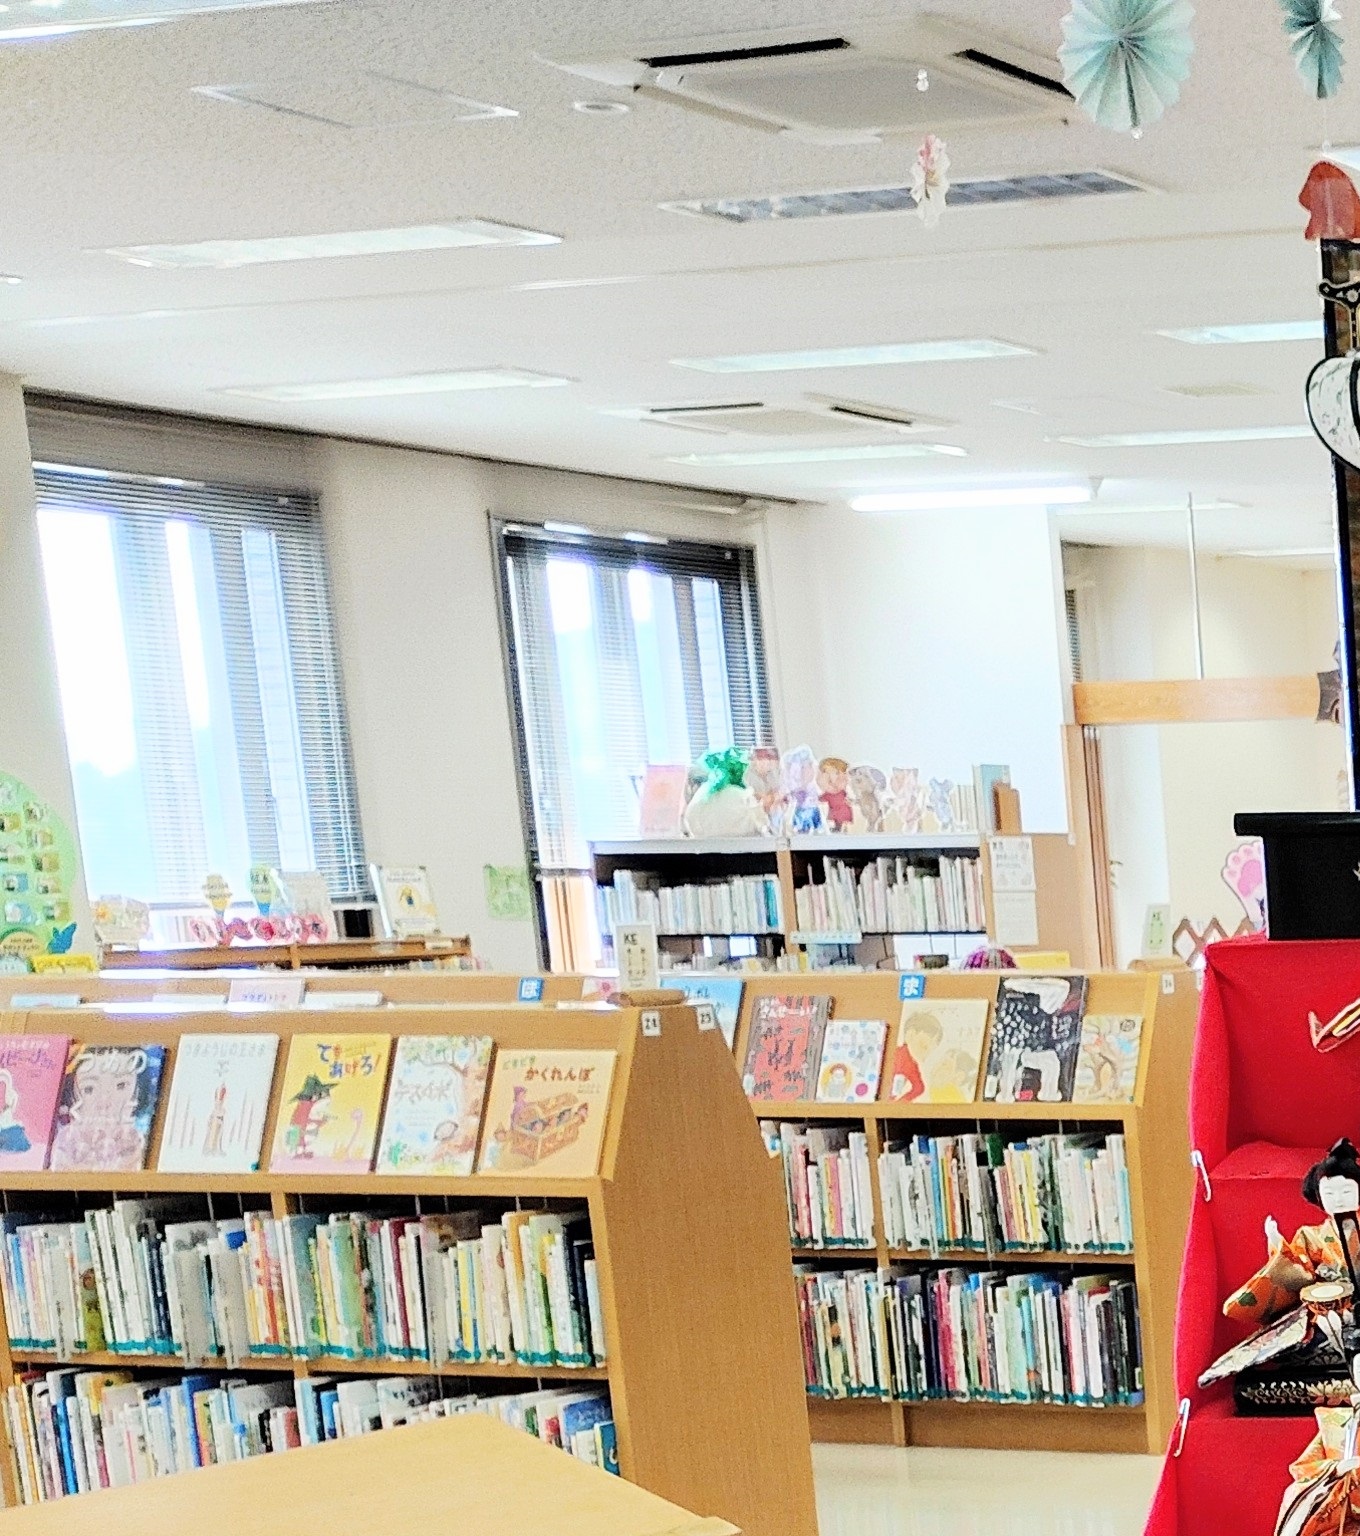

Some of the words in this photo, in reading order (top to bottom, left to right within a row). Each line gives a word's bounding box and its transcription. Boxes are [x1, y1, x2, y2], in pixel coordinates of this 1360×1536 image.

[902, 976, 920, 996] ま
[525, 1066, 597, 1082] かくれんぼ
